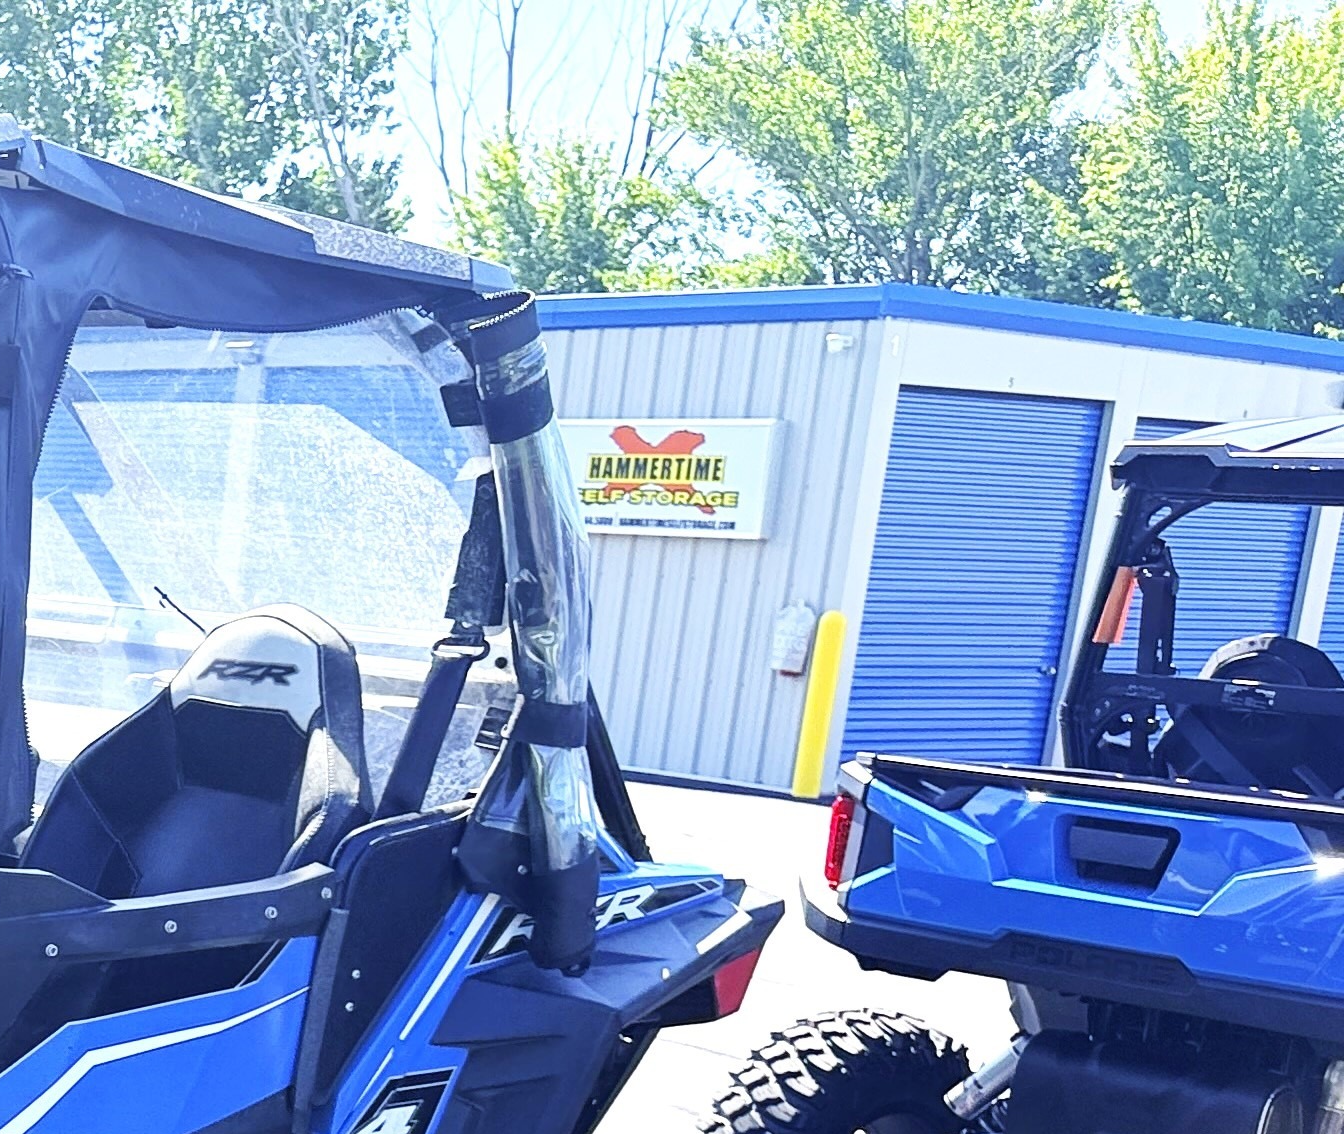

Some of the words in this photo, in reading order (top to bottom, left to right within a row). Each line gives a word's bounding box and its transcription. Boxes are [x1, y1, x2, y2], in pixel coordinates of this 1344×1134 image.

[588, 456, 724, 482] HAMMERTIME
[629, 488, 739, 508] STORAGE
[197, 658, 300, 686] RZR
